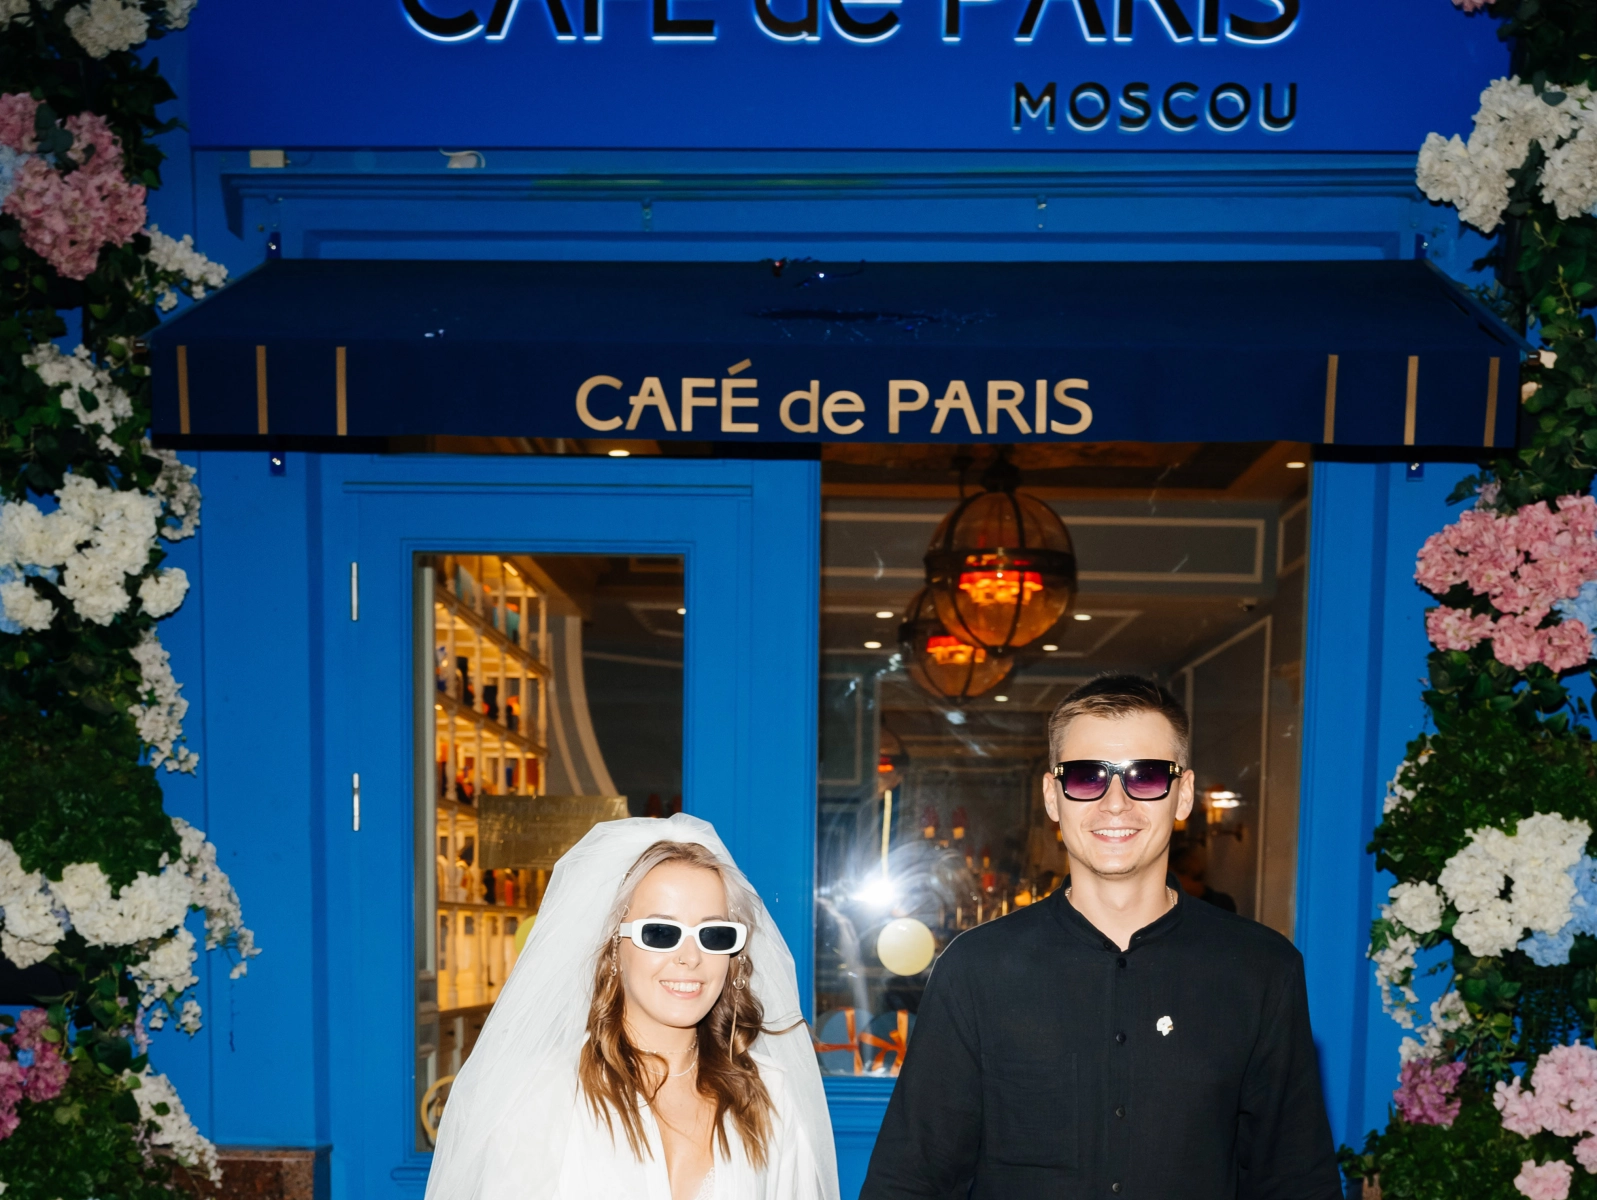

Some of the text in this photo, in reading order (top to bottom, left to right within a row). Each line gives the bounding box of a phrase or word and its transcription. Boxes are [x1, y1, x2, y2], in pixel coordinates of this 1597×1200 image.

[1012, 81, 1298, 133] MOSCOU
[575, 358, 1093, 435] CAFÉ de PARIS
